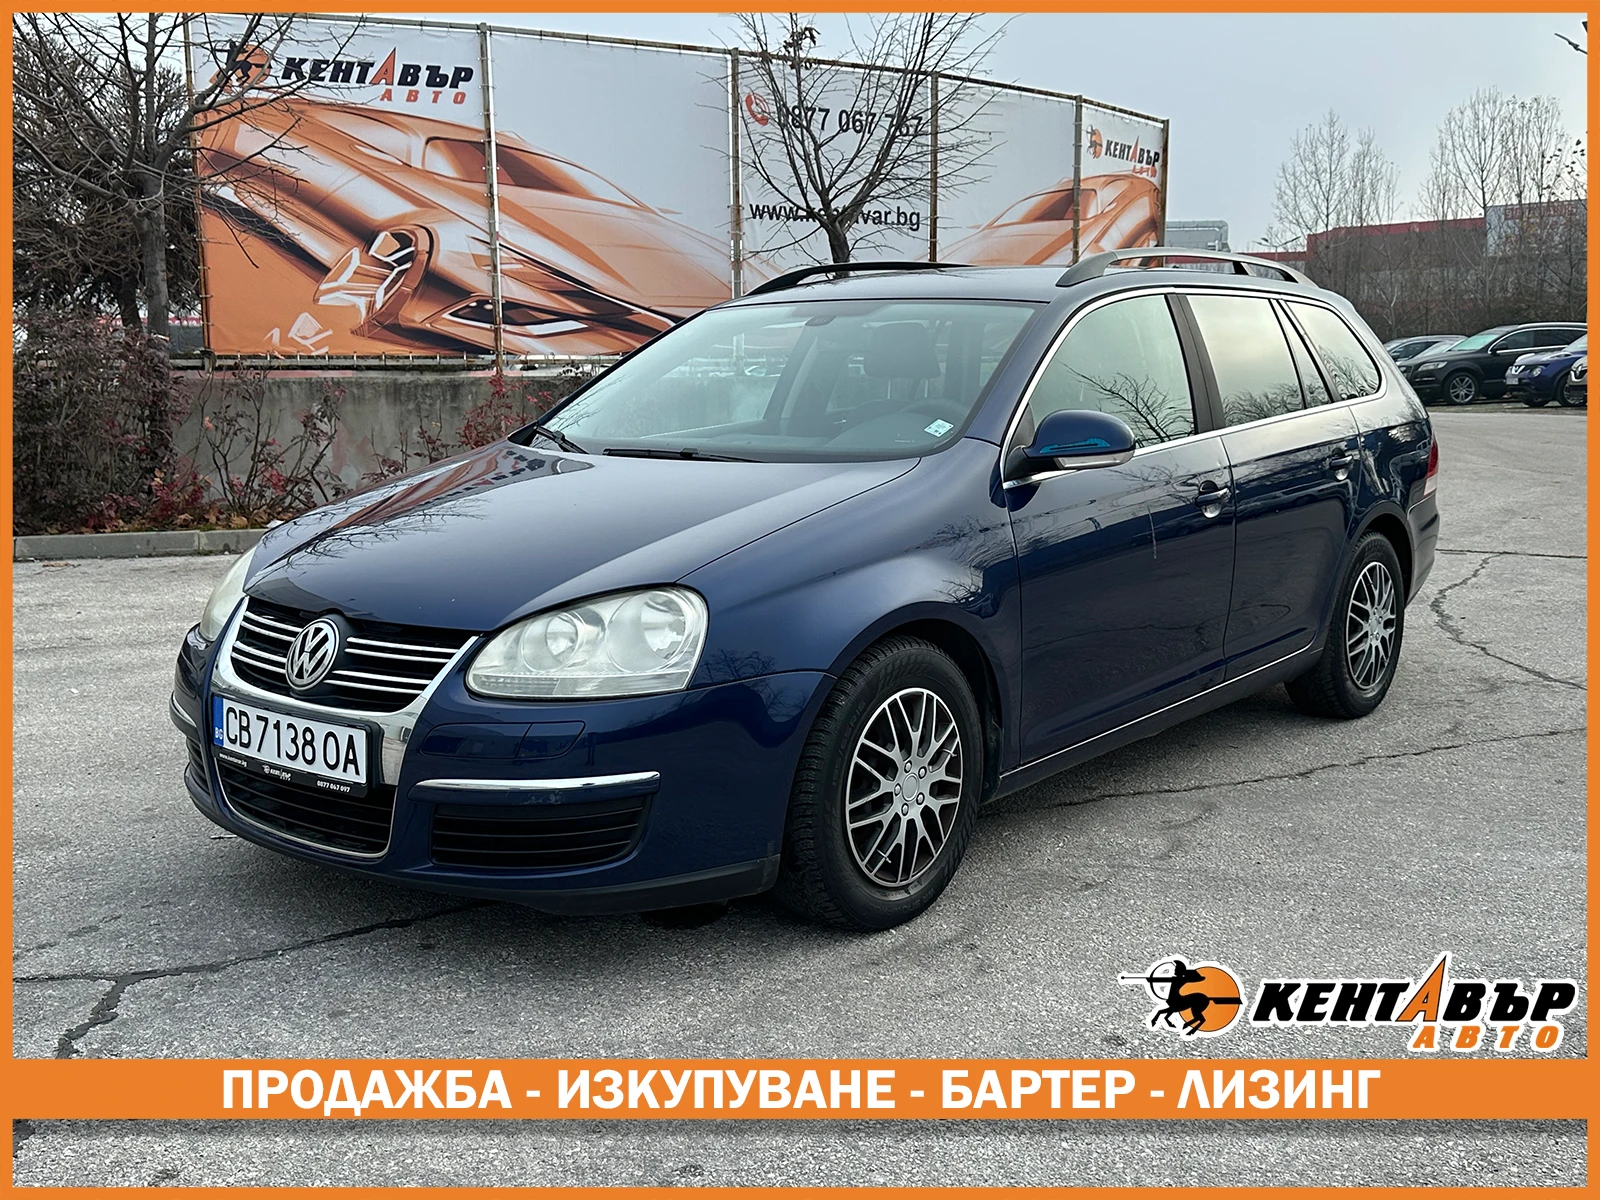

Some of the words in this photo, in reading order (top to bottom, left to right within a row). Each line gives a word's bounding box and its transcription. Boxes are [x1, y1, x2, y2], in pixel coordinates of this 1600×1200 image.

[281, 47, 474, 89] КЕНТАВЪР
[380, 88, 466, 105] АВТО
[838, 109, 876, 134] 067
[1105, 135, 1160, 167] КЕНТАВЪР
[215, 727, 224, 740] BG
